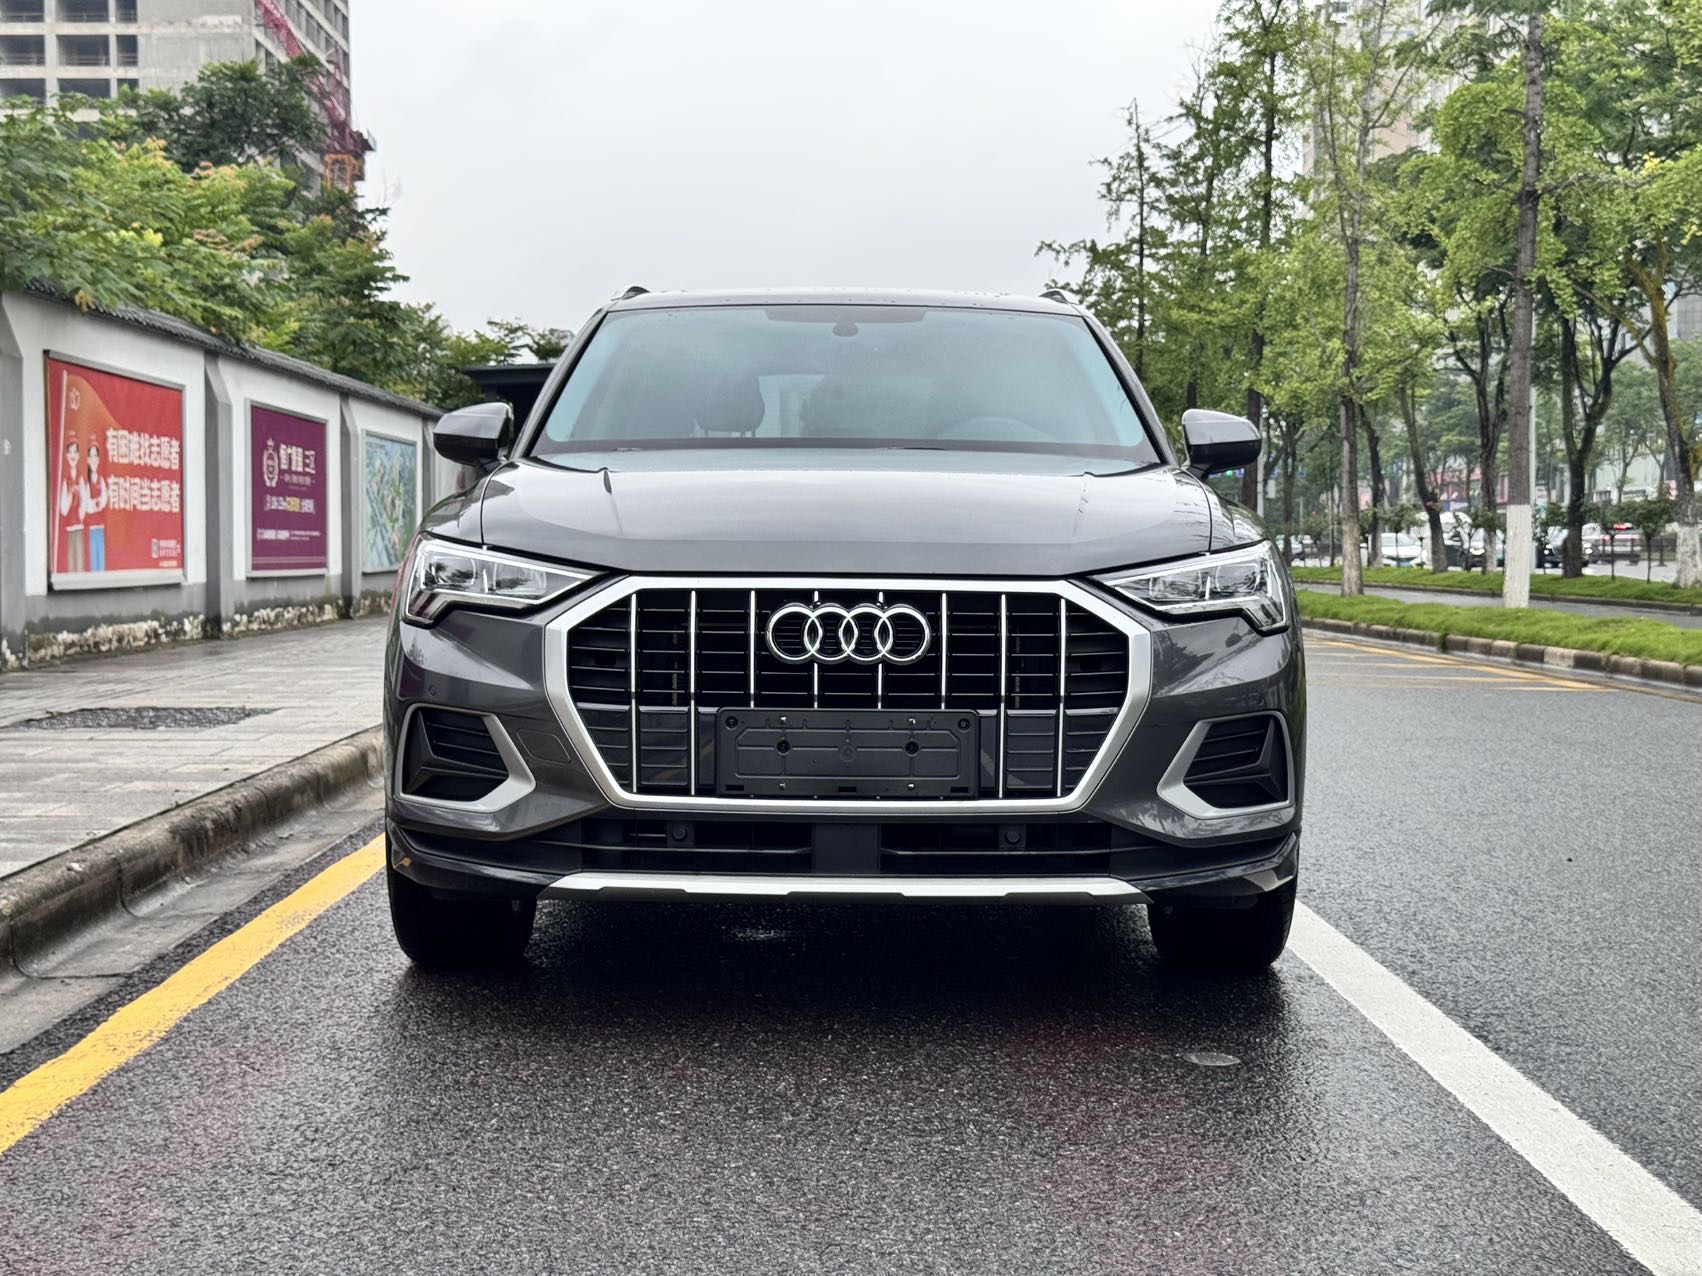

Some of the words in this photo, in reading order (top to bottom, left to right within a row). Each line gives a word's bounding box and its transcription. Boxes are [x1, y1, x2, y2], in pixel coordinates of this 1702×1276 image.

[106, 428, 180, 470] 有困难找志愿者
[107, 475, 180, 513] 有时间当志愿者
